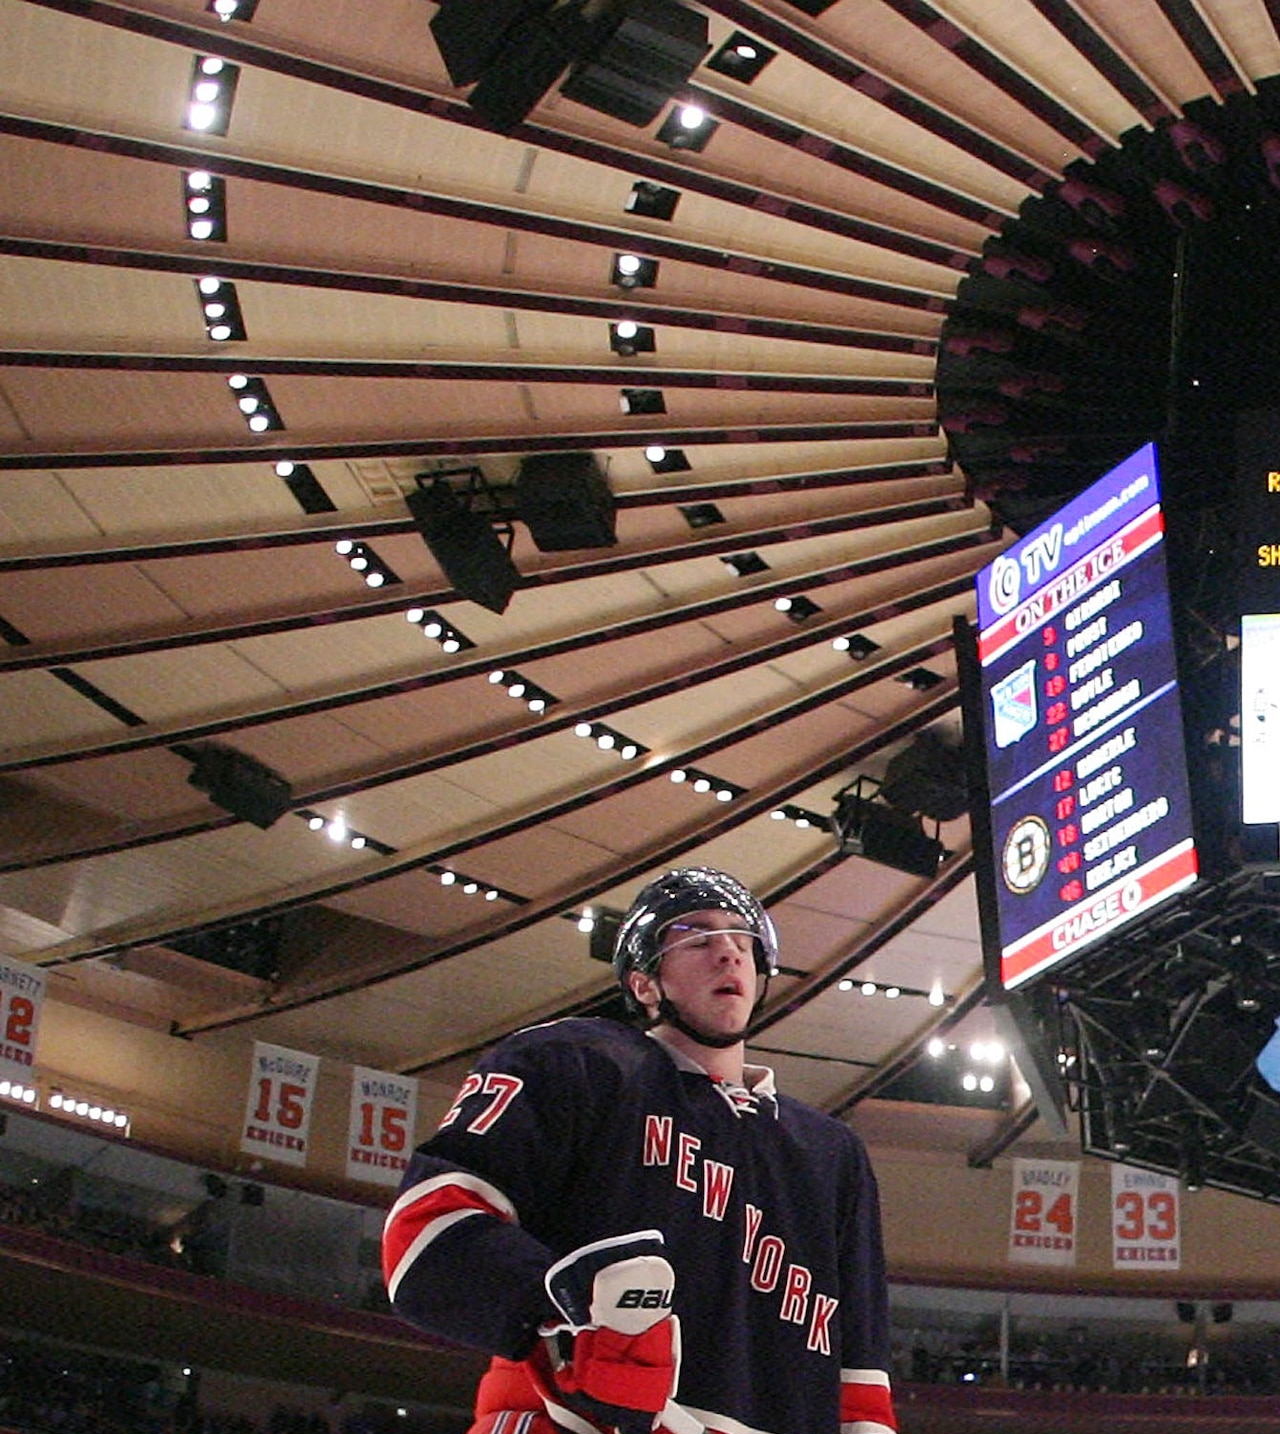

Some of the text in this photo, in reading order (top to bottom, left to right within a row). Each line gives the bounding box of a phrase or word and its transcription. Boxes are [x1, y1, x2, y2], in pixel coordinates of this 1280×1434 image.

[1014, 539, 1126, 633] ON THE ICE
[1052, 890, 1121, 950] CHASE
[254, 1078, 307, 1129] 15
[359, 1102, 408, 1151] 15
[438, 1072, 524, 1136] 27
[643, 1115, 840, 1356] NEW YORK
[1015, 1190, 1073, 1234] 24
[1116, 1192, 1176, 1240] 33
